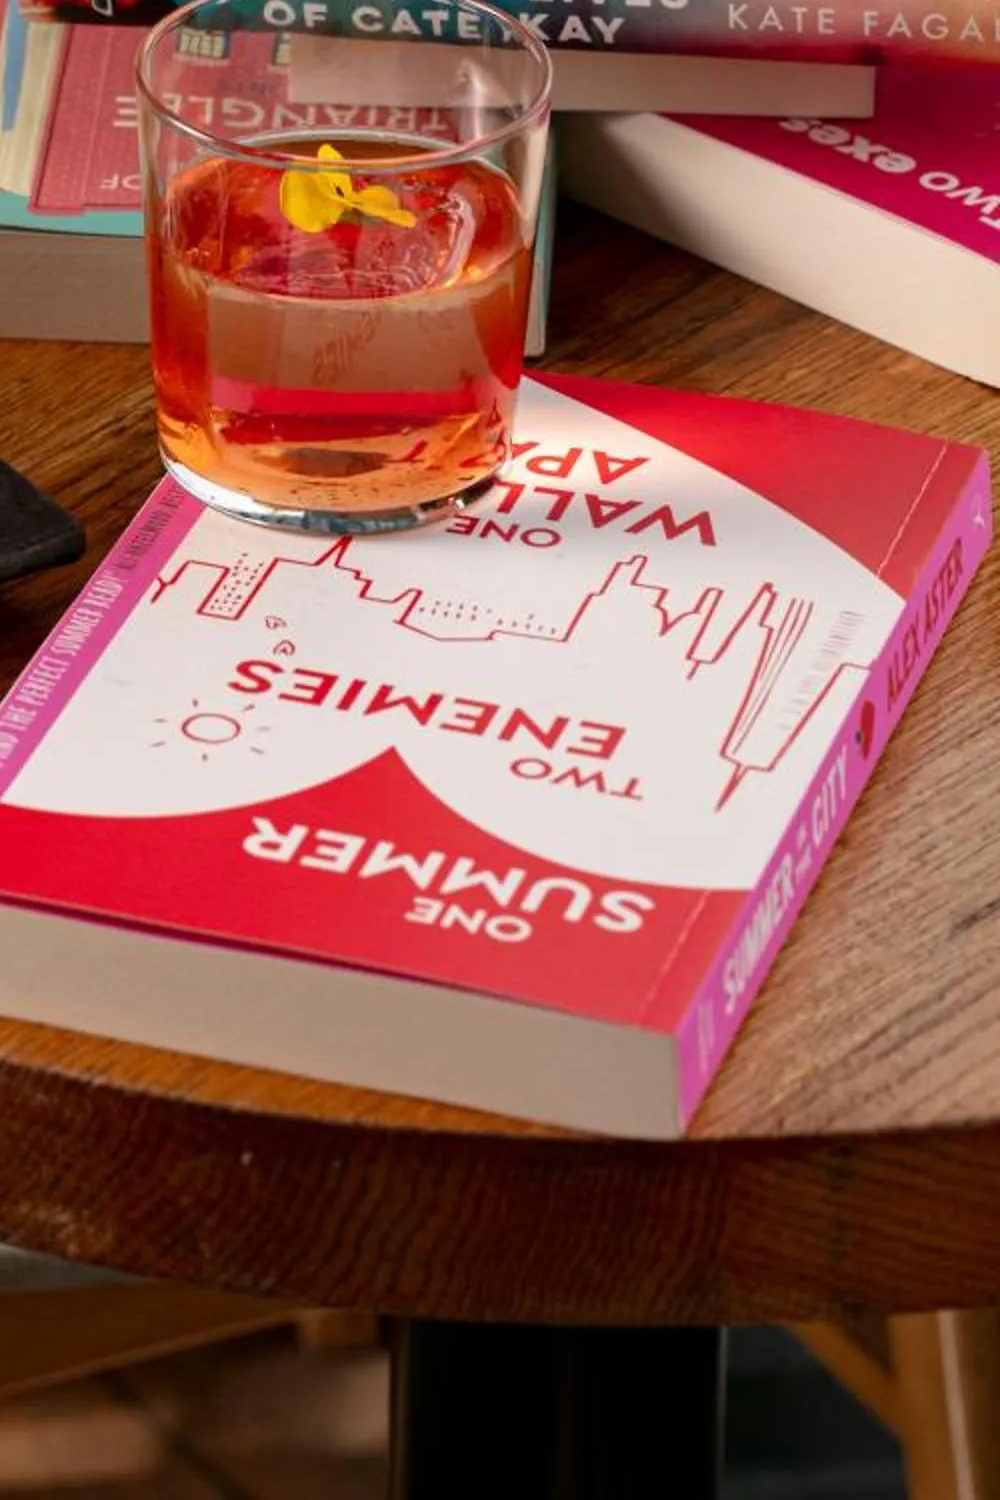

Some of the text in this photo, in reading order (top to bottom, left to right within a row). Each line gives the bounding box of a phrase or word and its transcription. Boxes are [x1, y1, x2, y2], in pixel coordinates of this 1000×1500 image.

[263, 0, 626, 45] OF CATE KAY
[727, 3, 1000, 43] KATE FAGA
[444, 513, 563, 549] ONE
[491, 474, 718, 548] WALL
[885, 536, 965, 714] ALEX ASTER
[227, 658, 628, 761] ENEMIES
[509, 757, 644, 801] TWO
[811, 744, 849, 847] CITY
[241, 815, 657, 934] SUMMER
[404, 895, 534, 944] ONE
